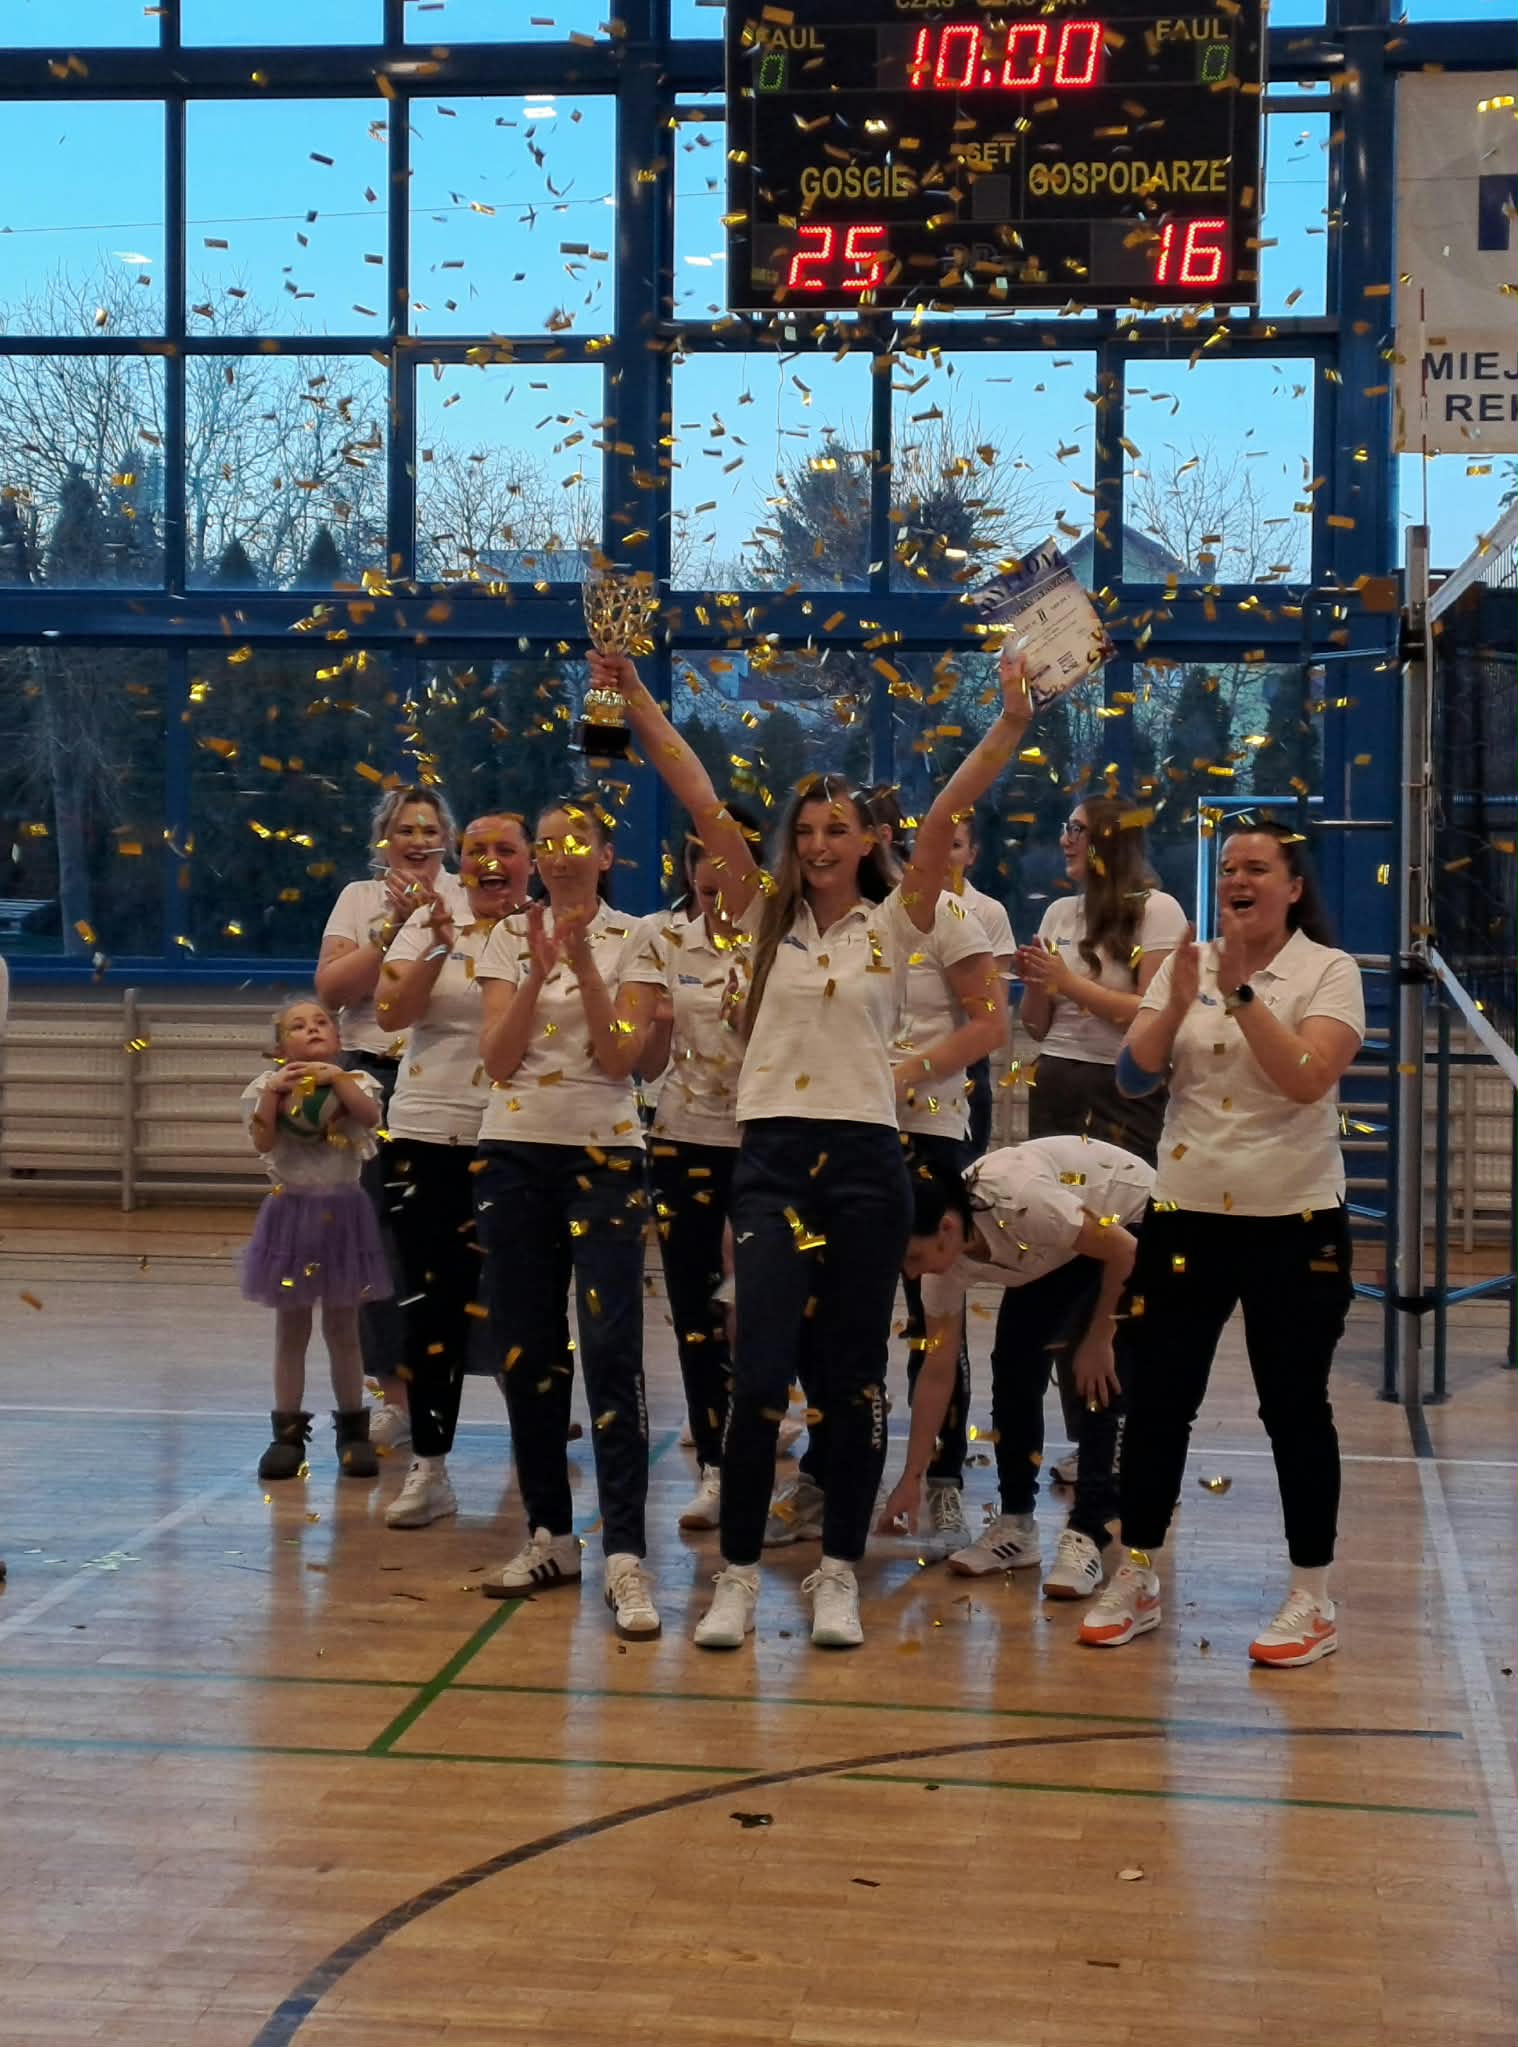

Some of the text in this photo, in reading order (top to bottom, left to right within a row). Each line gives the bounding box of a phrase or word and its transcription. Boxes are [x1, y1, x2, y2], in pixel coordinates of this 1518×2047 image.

[756, 27, 825, 49] AUL
[1156, 18, 1229, 40] FAUL
[759, 53, 785, 90] 0
[1201, 44, 1230, 81] 0
[967, 142, 1016, 164] SET
[800, 157, 909, 199] GOŚCIE
[1028, 160, 1227, 196] GOSPODARZE
[788, 225, 884, 288] 25
[1156, 220, 1226, 283] 16
[1445, 393, 1518, 422] RE
